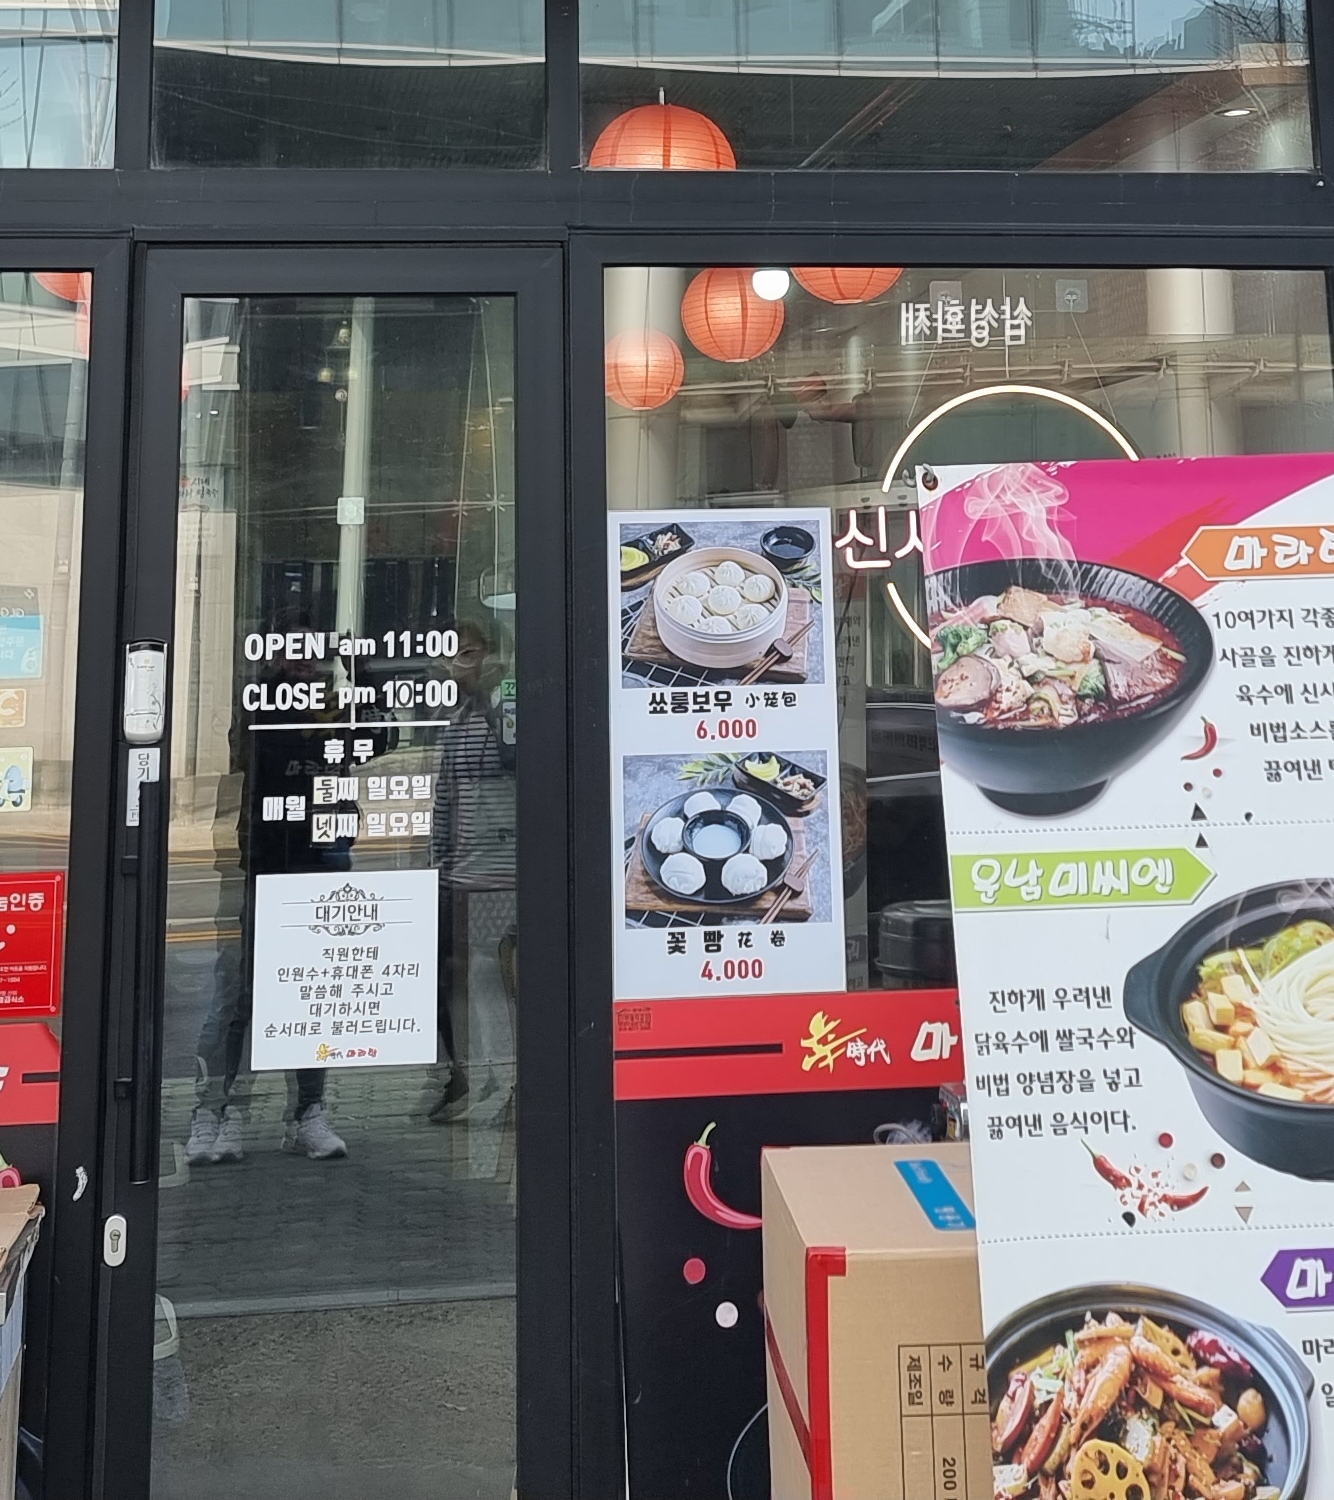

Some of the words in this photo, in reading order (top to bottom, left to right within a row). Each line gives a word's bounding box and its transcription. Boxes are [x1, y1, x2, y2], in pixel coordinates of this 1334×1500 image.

[1212, 607, 1295, 631] 10여가지
[244, 632, 324, 660] OPEN
[338, 636, 376, 656] am
[382, 630, 459, 658] 11:00
[1218, 646, 1277, 669] 사골을
[243, 682, 325, 711] CLOSE
[338, 687, 376, 709] pm
[382, 679, 459, 708] 10:00
[1235, 683, 1295, 706] 육수에
[696, 718, 758, 741] 6.000
[1263, 758, 1323, 783] 끓여낸
[313, 775, 359, 804] 둘째
[367, 774, 432, 800] 일요일
[262, 795, 306, 822] 매월
[312, 812, 359, 843] 넷째
[367, 811, 432, 837] 일요일
[315, 904, 378, 922] 대기안내
[322, 946, 379, 962] 직원한테
[277, 965, 374, 982] 인원수+휴대폰
[382, 963, 420, 978] 4자리
[700, 959, 763, 981] 4.000
[300, 985, 343, 1001] 말씀해
[351, 983, 394, 998] 주시고
[988, 988, 1046, 1014] 진하게
[1052, 986, 1113, 1010] 우려낸
[309, 1001, 381, 1018] 대기하시면
[264, 1022, 323, 1038] 순서대로
[330, 1018, 421, 1036] 불러드립니다.
[974, 1029, 1050, 1056] 닭육수에
[1055, 1026, 1137, 1052] 쌀국수와
[974, 1073, 1010, 1098] 비법
[1016, 1069, 1097, 1096] 양념장을
[1102, 1067, 1143, 1092] 넣고
[986, 1114, 1044, 1141] 끓여낸
[1049, 1110, 1138, 1137] 음식이다.
[907, 1355, 924, 1407] 제조일
[943, 1457, 957, 1490] 200
